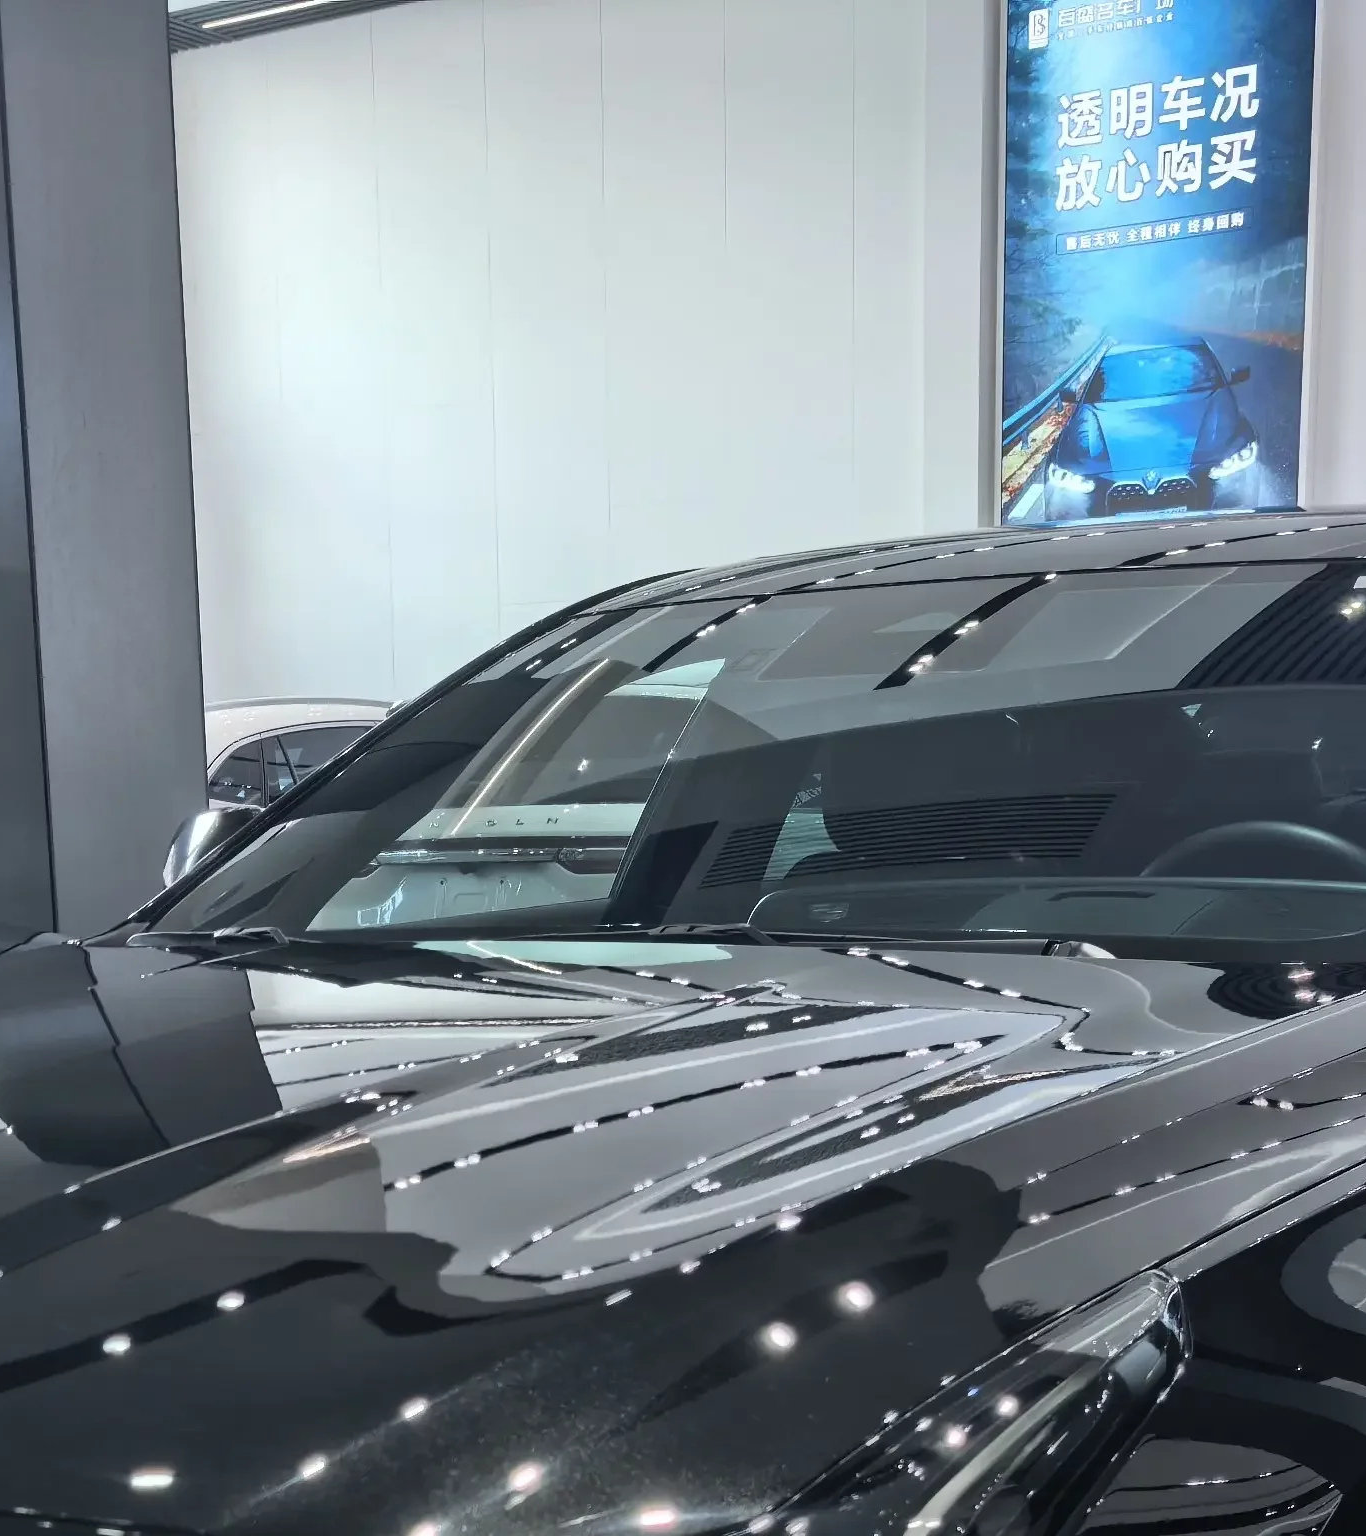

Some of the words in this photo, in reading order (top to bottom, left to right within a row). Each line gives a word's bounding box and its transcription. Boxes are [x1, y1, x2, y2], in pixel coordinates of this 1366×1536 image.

[1057, 63, 1260, 150] 透明车况
[1054, 129, 1258, 213] 放心购买
